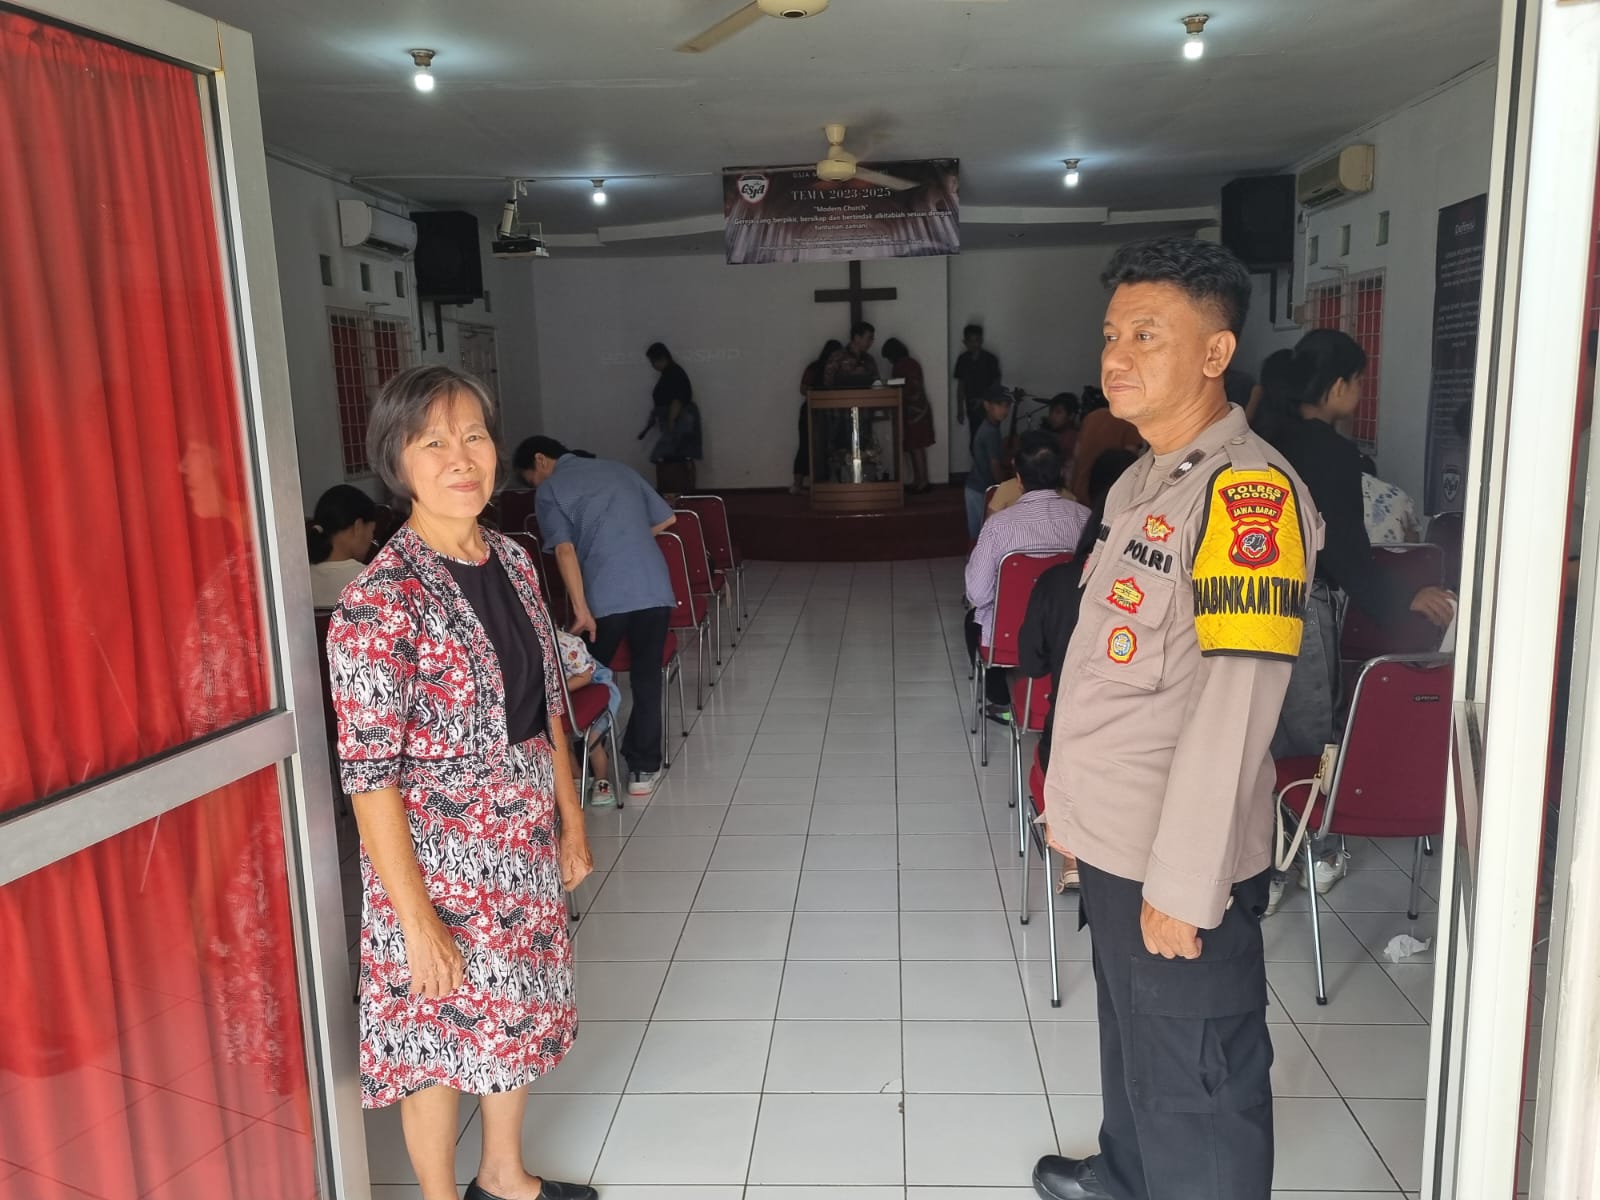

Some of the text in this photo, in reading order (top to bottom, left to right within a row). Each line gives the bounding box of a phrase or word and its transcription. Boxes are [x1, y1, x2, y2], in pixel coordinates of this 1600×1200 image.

[791, 188, 892, 201] TEMA 2023-2025
[734, 218, 754, 226] Gereja
[928, 209, 952, 218] dengan
[1227, 484, 1282, 498] POLRES
[1233, 506, 1277, 517] JAWA BARAT
[1123, 539, 1173, 574] POLRI
